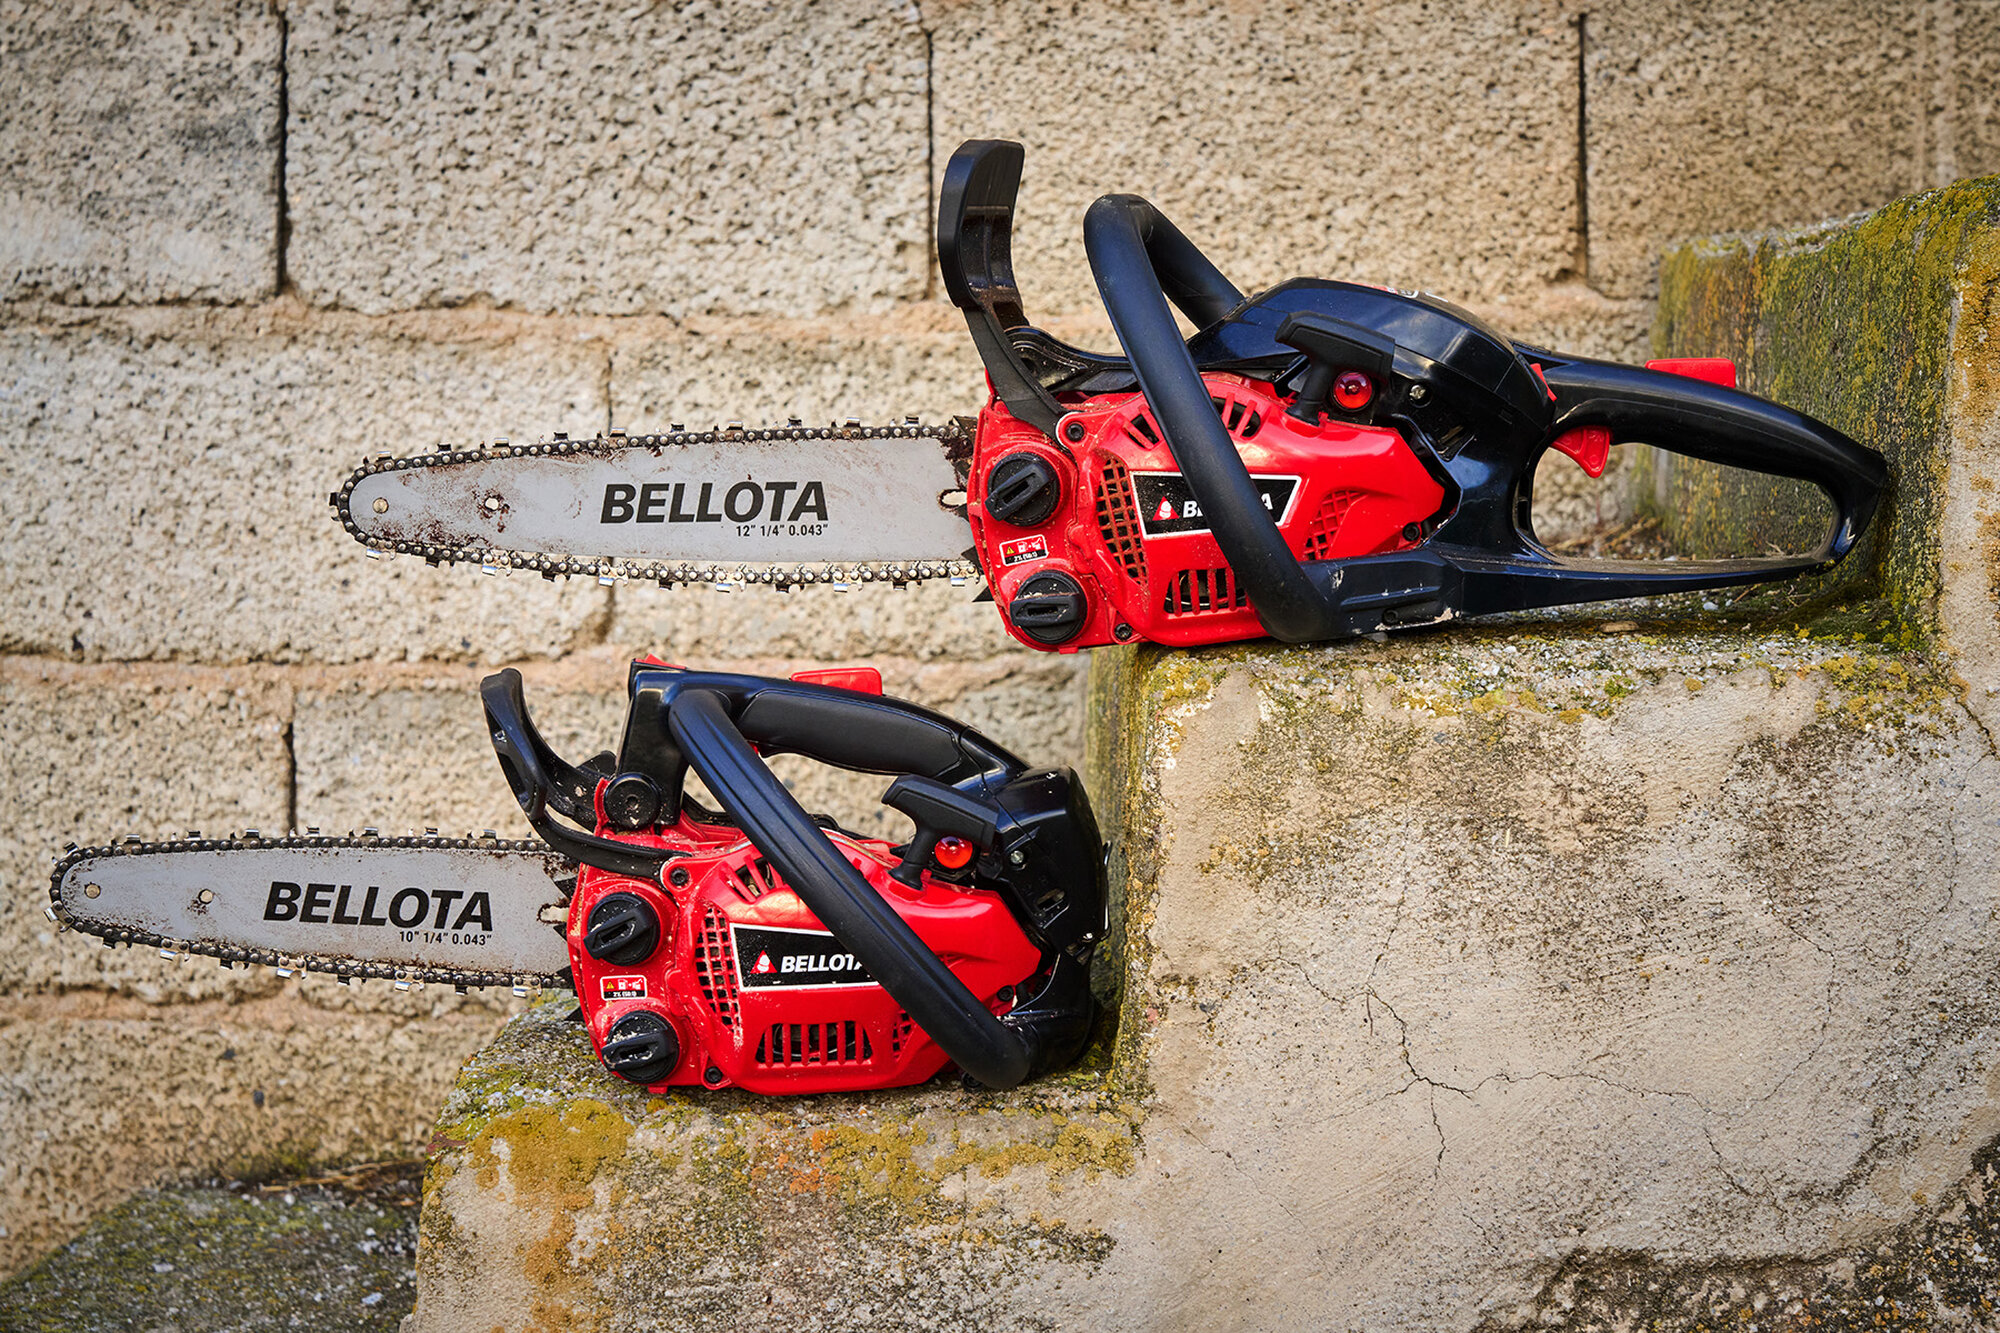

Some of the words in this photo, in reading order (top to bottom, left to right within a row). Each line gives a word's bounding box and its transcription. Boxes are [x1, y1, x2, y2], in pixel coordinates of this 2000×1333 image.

[600, 481, 829, 524] BELLOTA
[735, 524, 756, 537] 12"
[760, 524, 785, 537] 1/4"
[788, 523, 829, 536] 0.043"
[263, 881, 493, 932] BELLOTA
[399, 930, 420, 943] 10"
[423, 932, 449, 945] 1/4"
[452, 933, 492, 946] 0.043"
